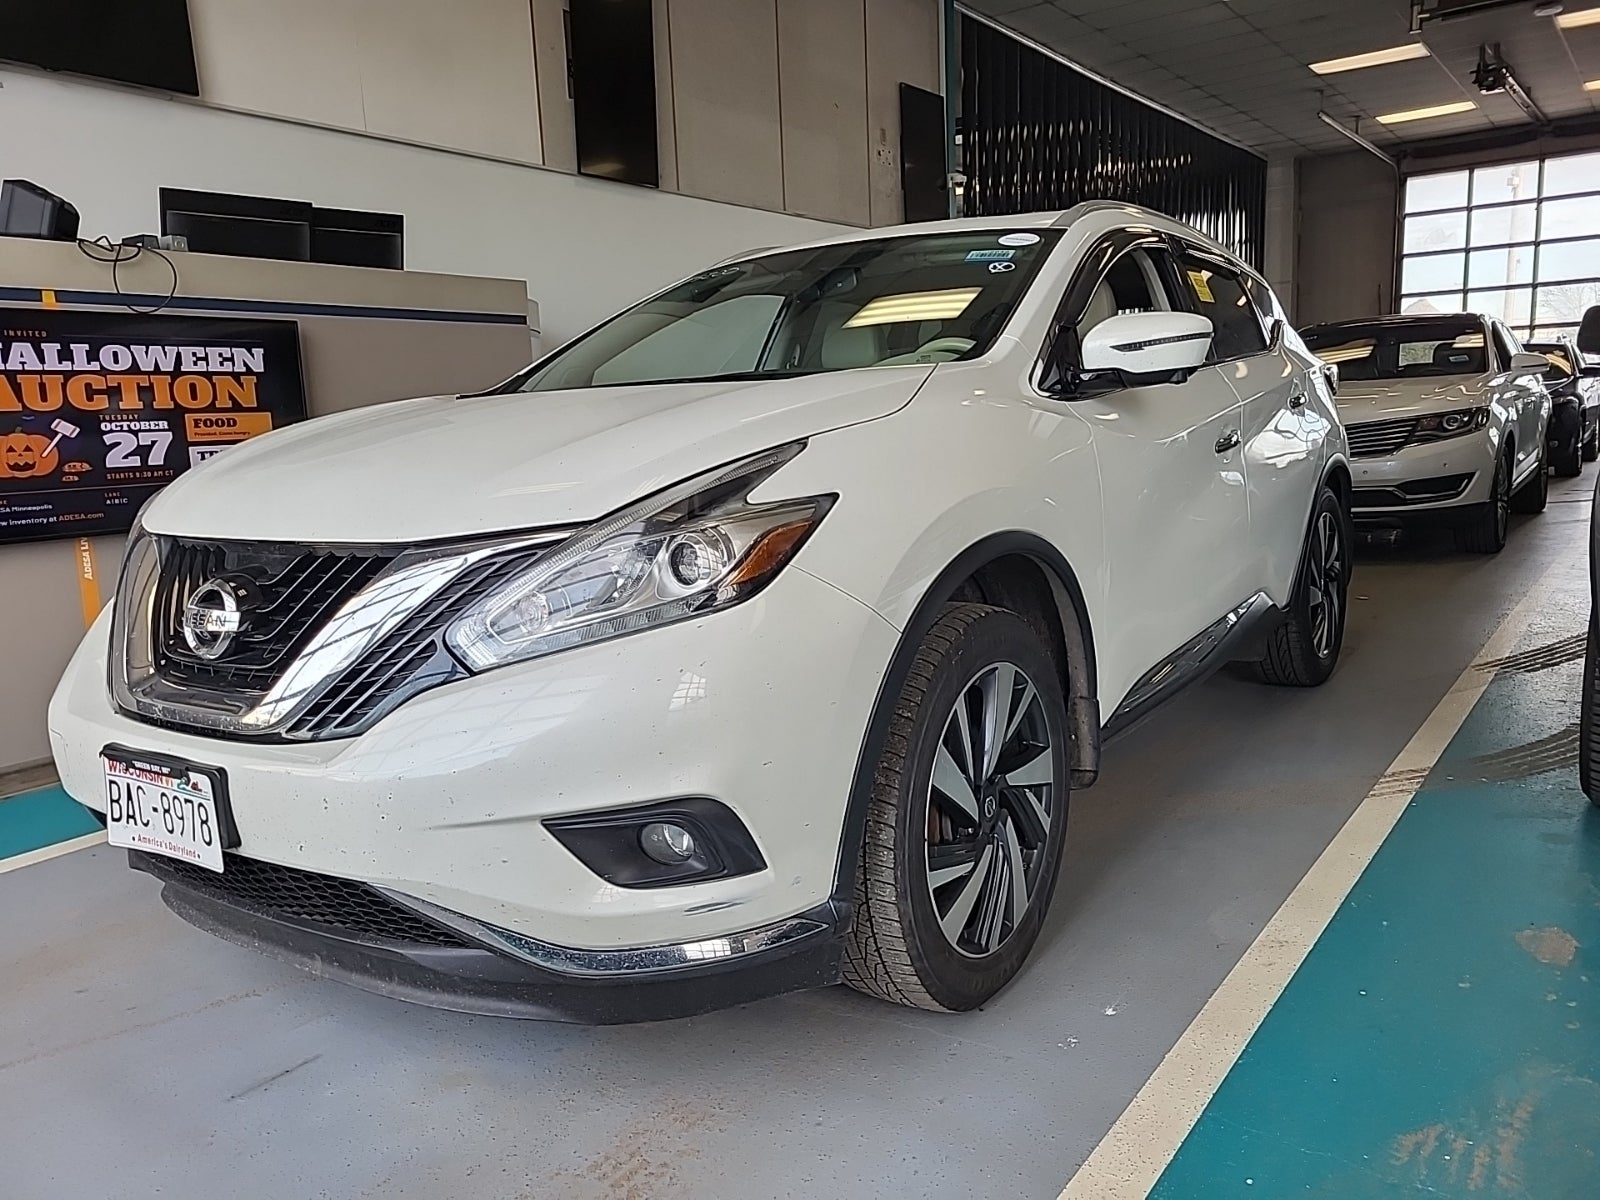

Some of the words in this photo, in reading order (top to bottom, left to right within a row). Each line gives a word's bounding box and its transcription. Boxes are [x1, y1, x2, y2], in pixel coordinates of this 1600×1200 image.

[4, 329, 47, 338] INVITED
[0, 342, 264, 372] ALLOWEEN
[100, 421, 168, 431] OCTOBER
[192, 417, 237, 428] FOOD
[103, 432, 173, 468] 27
[11, 504, 53, 512] Minneapolis
[9, 518, 48, 526] inventory
[59, 512, 104, 521] ADESA.com
[108, 778, 213, 847] BAC-8978
[137, 834, 168, 850] America's
[168, 841, 197, 858] Dairyland
